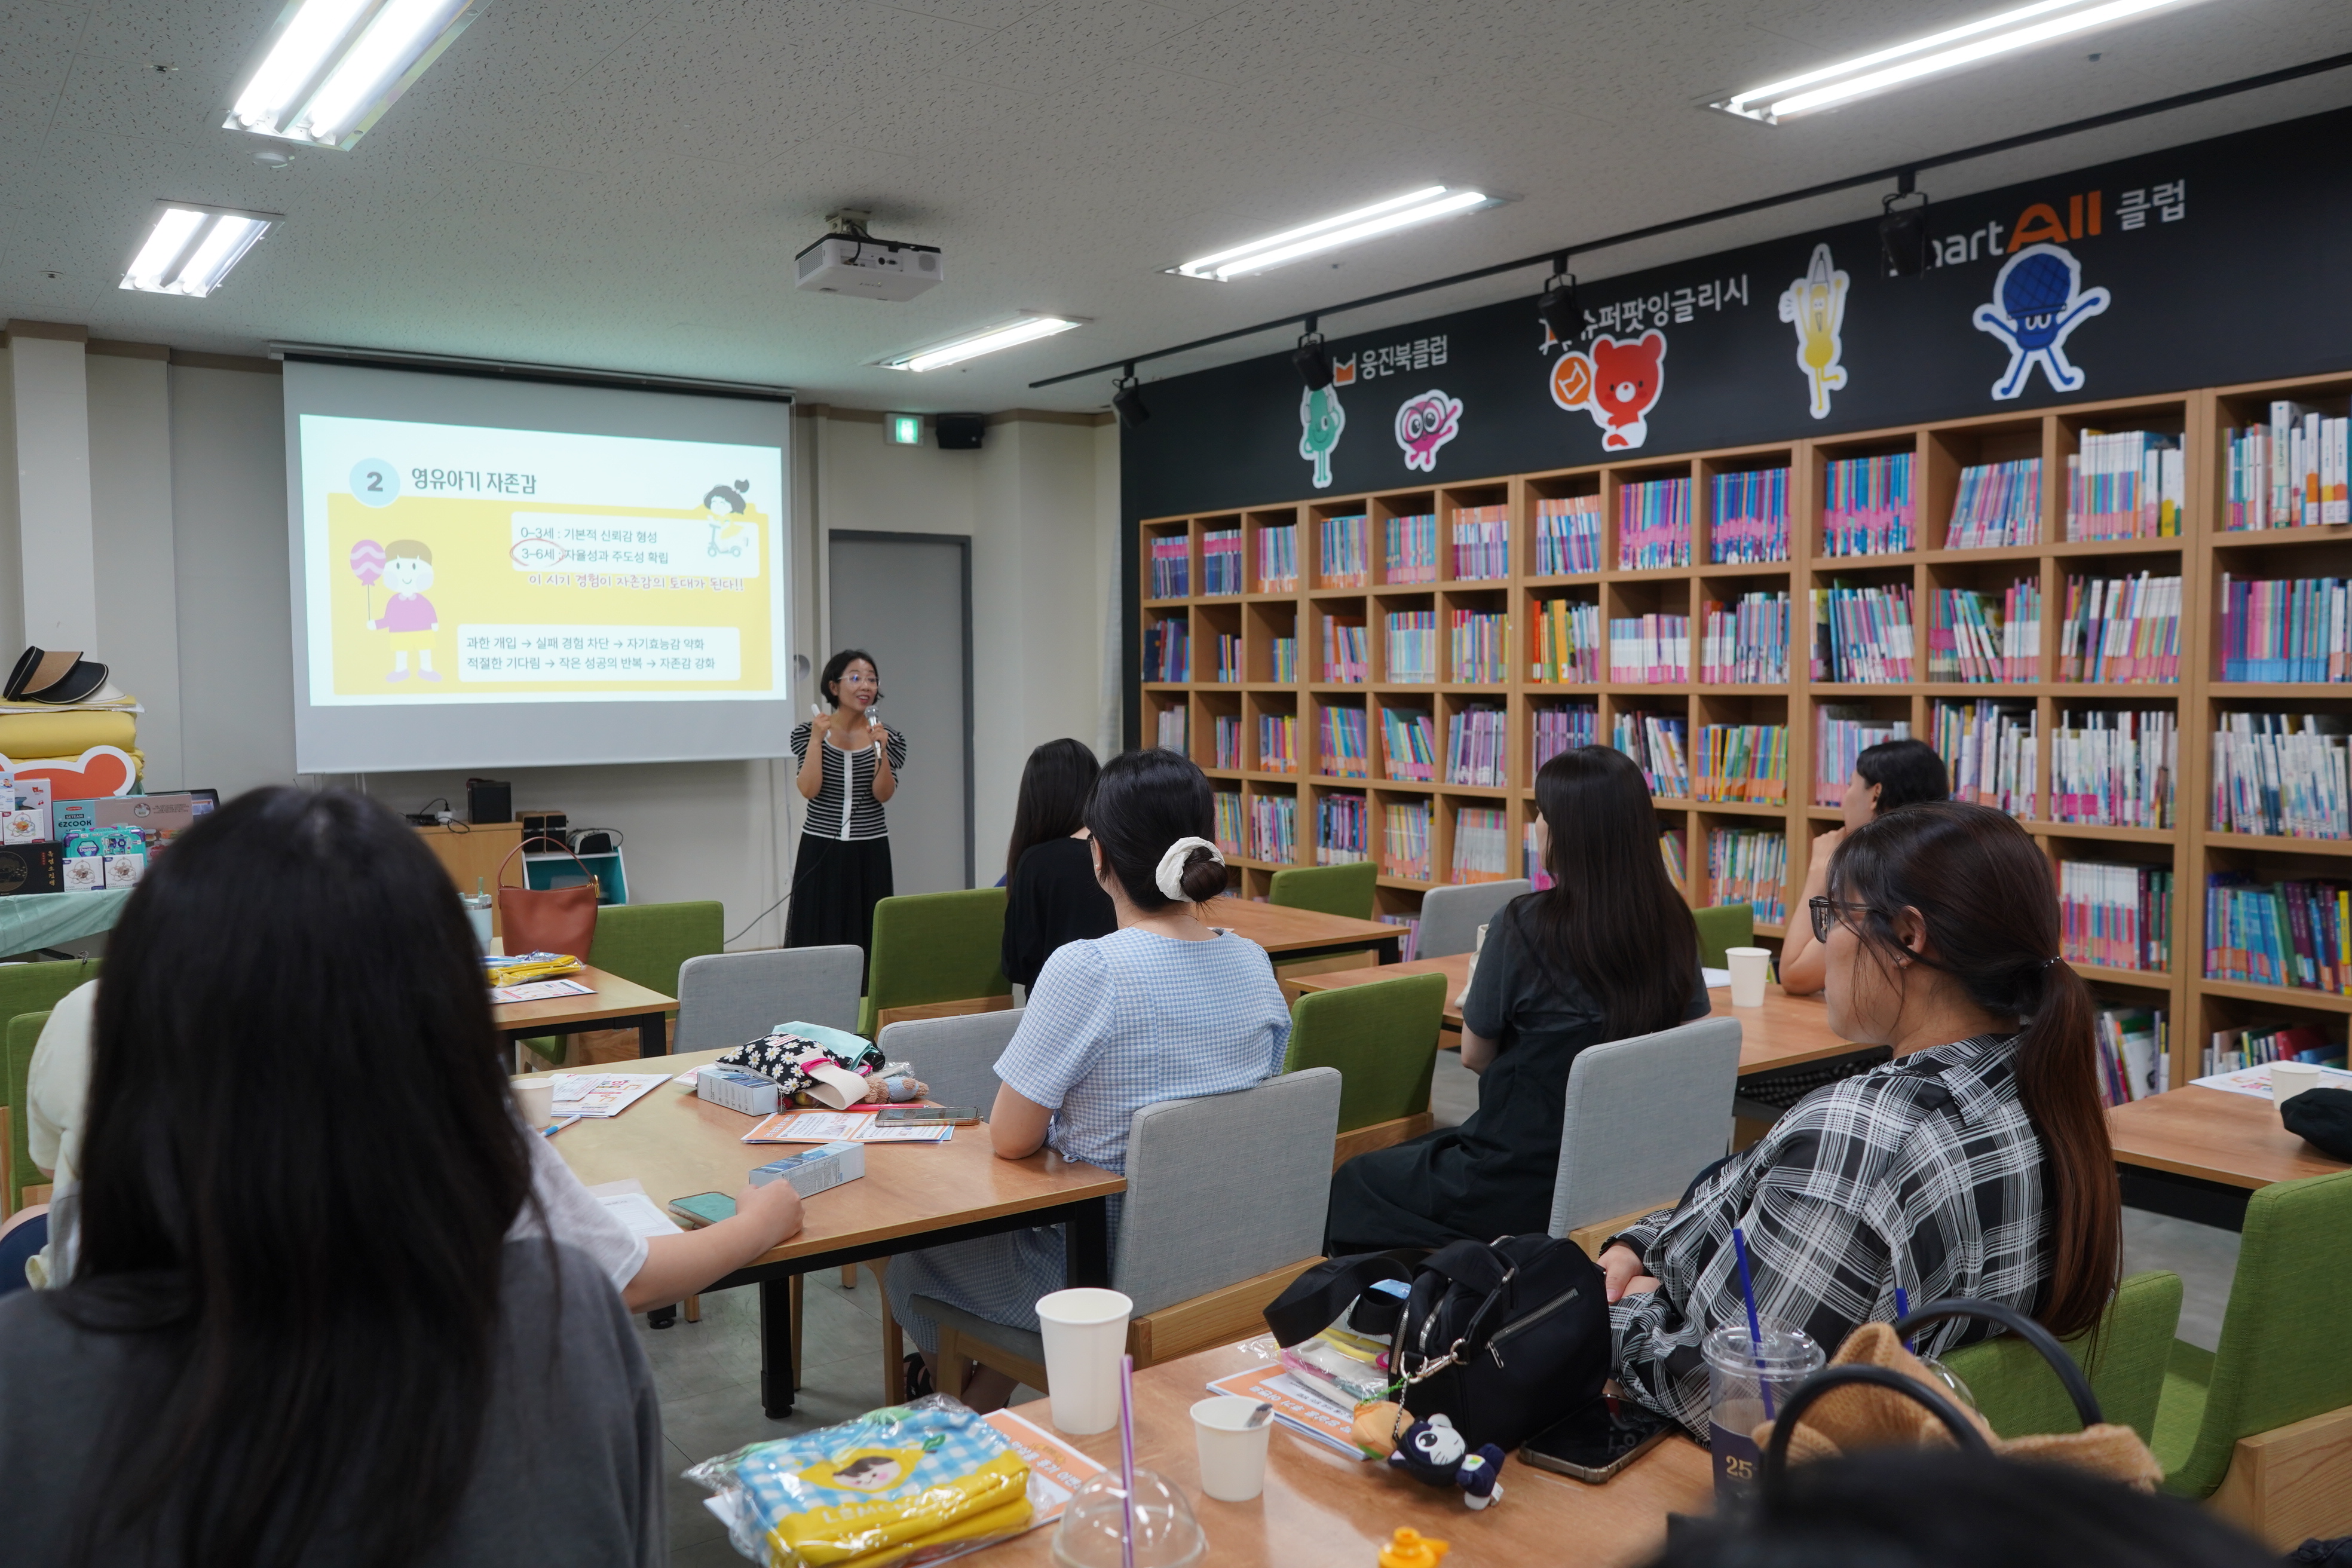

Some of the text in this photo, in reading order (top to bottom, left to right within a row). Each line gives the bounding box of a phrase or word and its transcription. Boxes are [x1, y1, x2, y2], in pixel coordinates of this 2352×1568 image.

[2115, 179, 2185, 231] 클럽
[1359, 334, 1448, 380] 웅진북클럽
[366, 471, 384, 492] 2
[411, 468, 537, 495] 영유아기 자존감
[564, 528, 597, 541] 기본적
[601, 529, 633, 543] 신뢰감
[636, 530, 657, 544] 형성
[564, 549, 609, 563] 자율성과
[612, 550, 644, 564] 주도성
[648, 551, 669, 565] 확립
[529, 574, 744, 591] 이 시기 경험이 자존감의 토대가 된다!!
[467, 636, 705, 650] 과한 개입 실패 경험 차단 자기효능감 약화
[467, 657, 715, 670] 적절한 기다림 작은 성공의 반복 자존감 강화
[1726, 1455, 1753, 1480] 25
